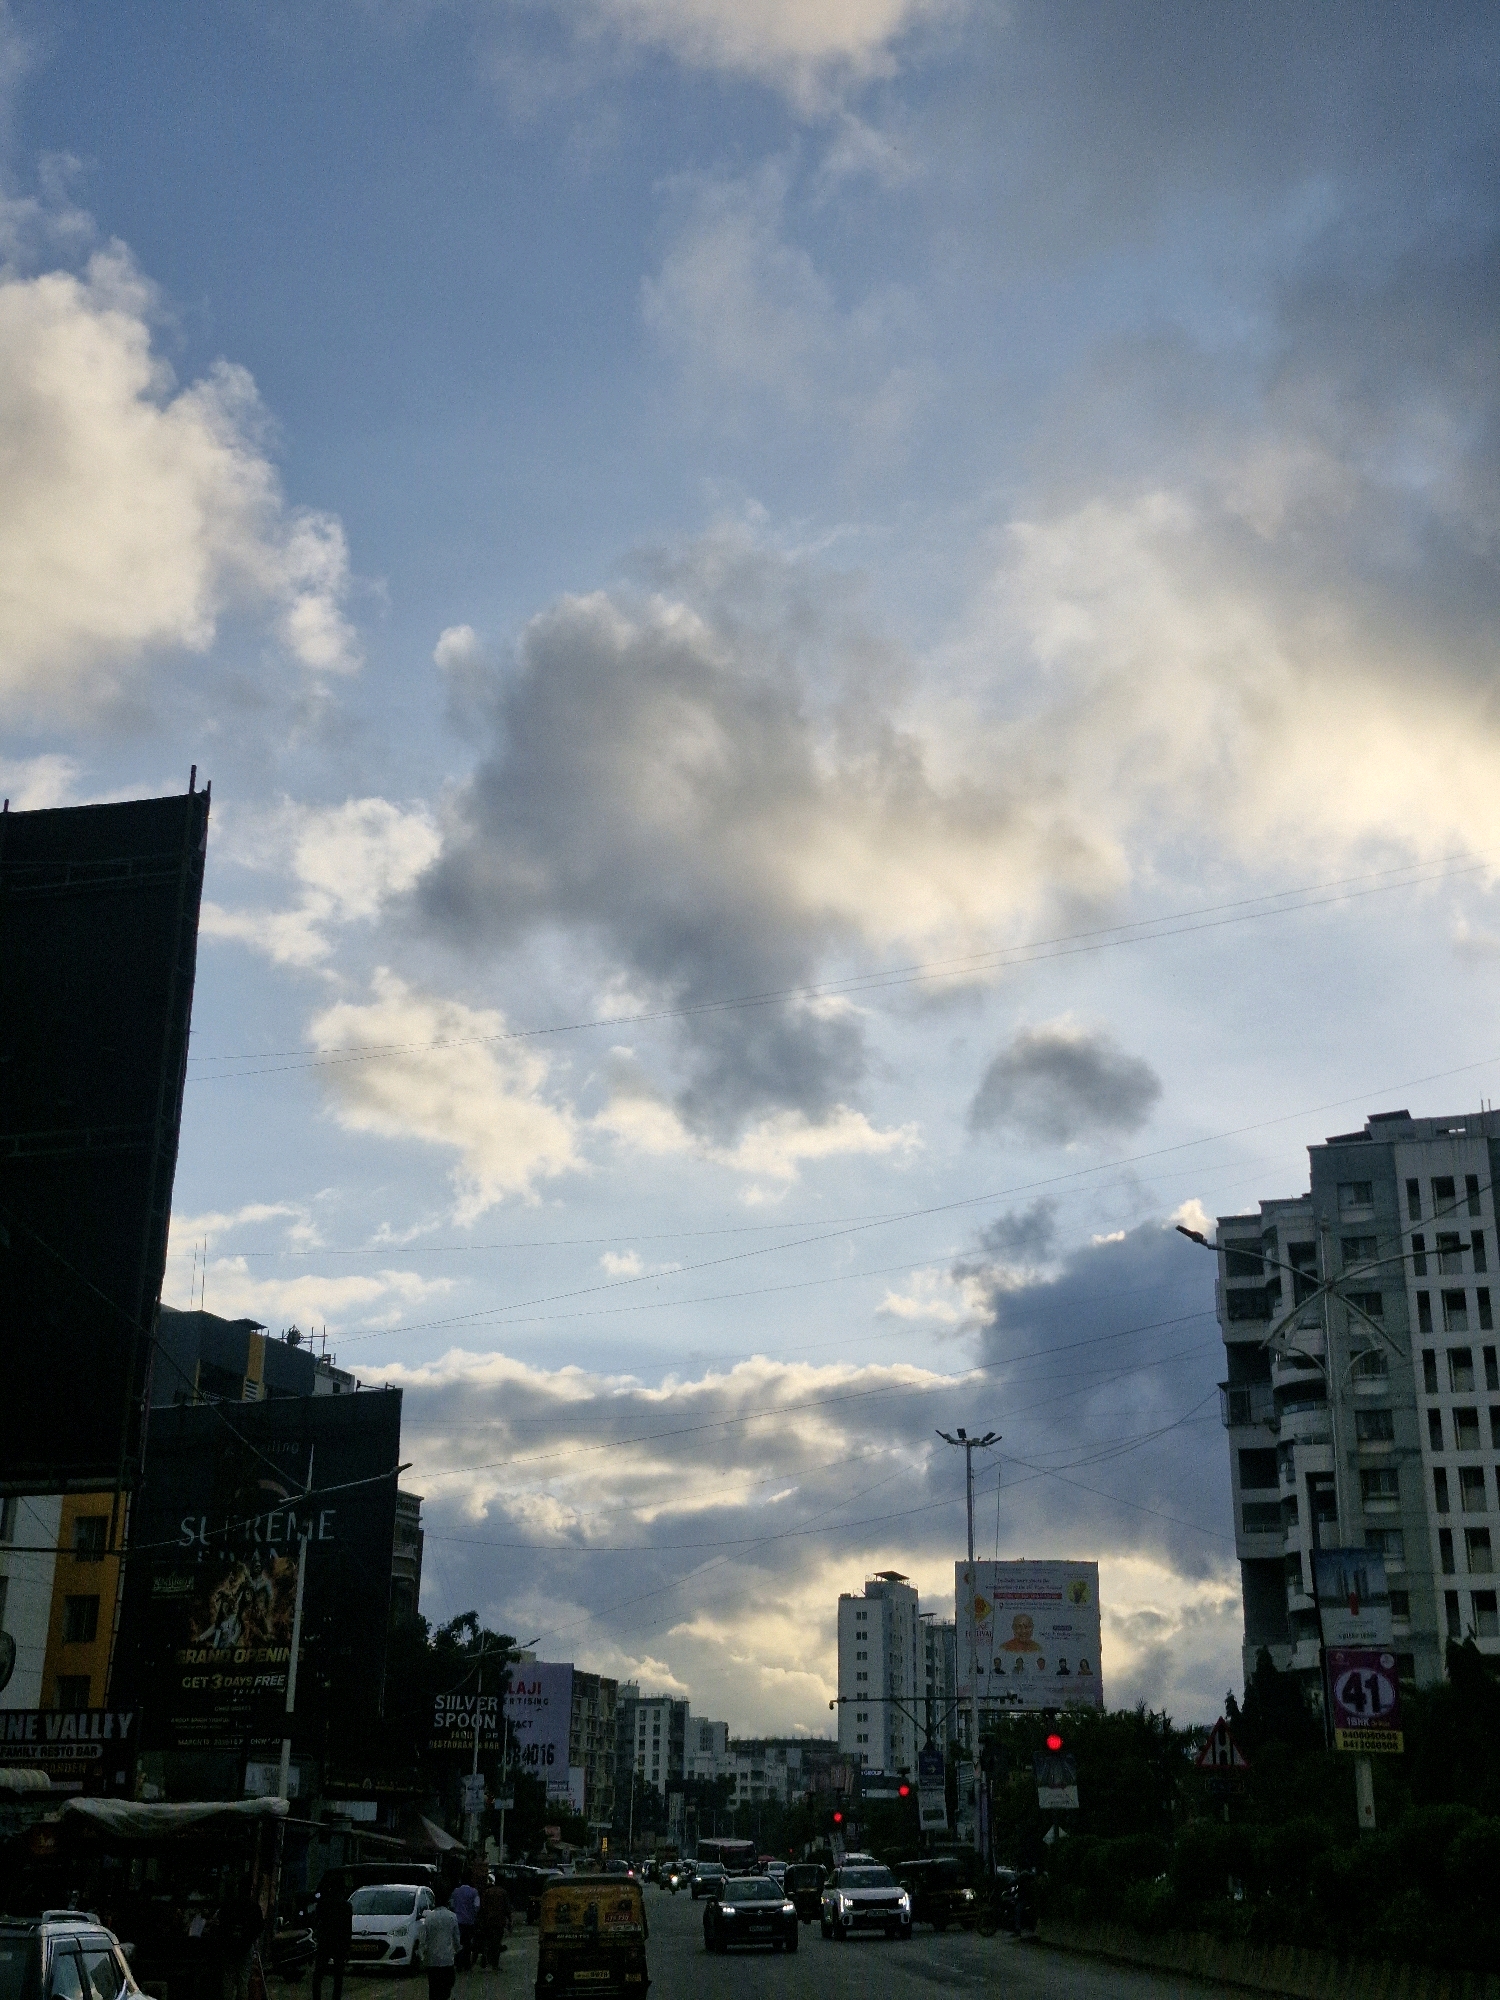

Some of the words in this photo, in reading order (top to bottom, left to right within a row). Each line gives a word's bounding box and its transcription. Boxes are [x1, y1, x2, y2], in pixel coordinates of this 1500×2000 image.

[178, 1649, 231, 1665] GRAND
[181, 1676, 209, 1689] GET
[211, 1673, 224, 1690] 3
[224, 1675, 254, 1687] DAYS
[254, 1674, 287, 1688] FREE
[1343, 1671, 1380, 1713] 41
[45, 1711, 134, 1740] VALLEY
[432, 1712, 497, 1729] SPOON
[40, 1746, 73, 1757] RESTO
[76, 1746, 98, 1757] BAR
[429, 1739, 478, 1749] RESTAURAN
